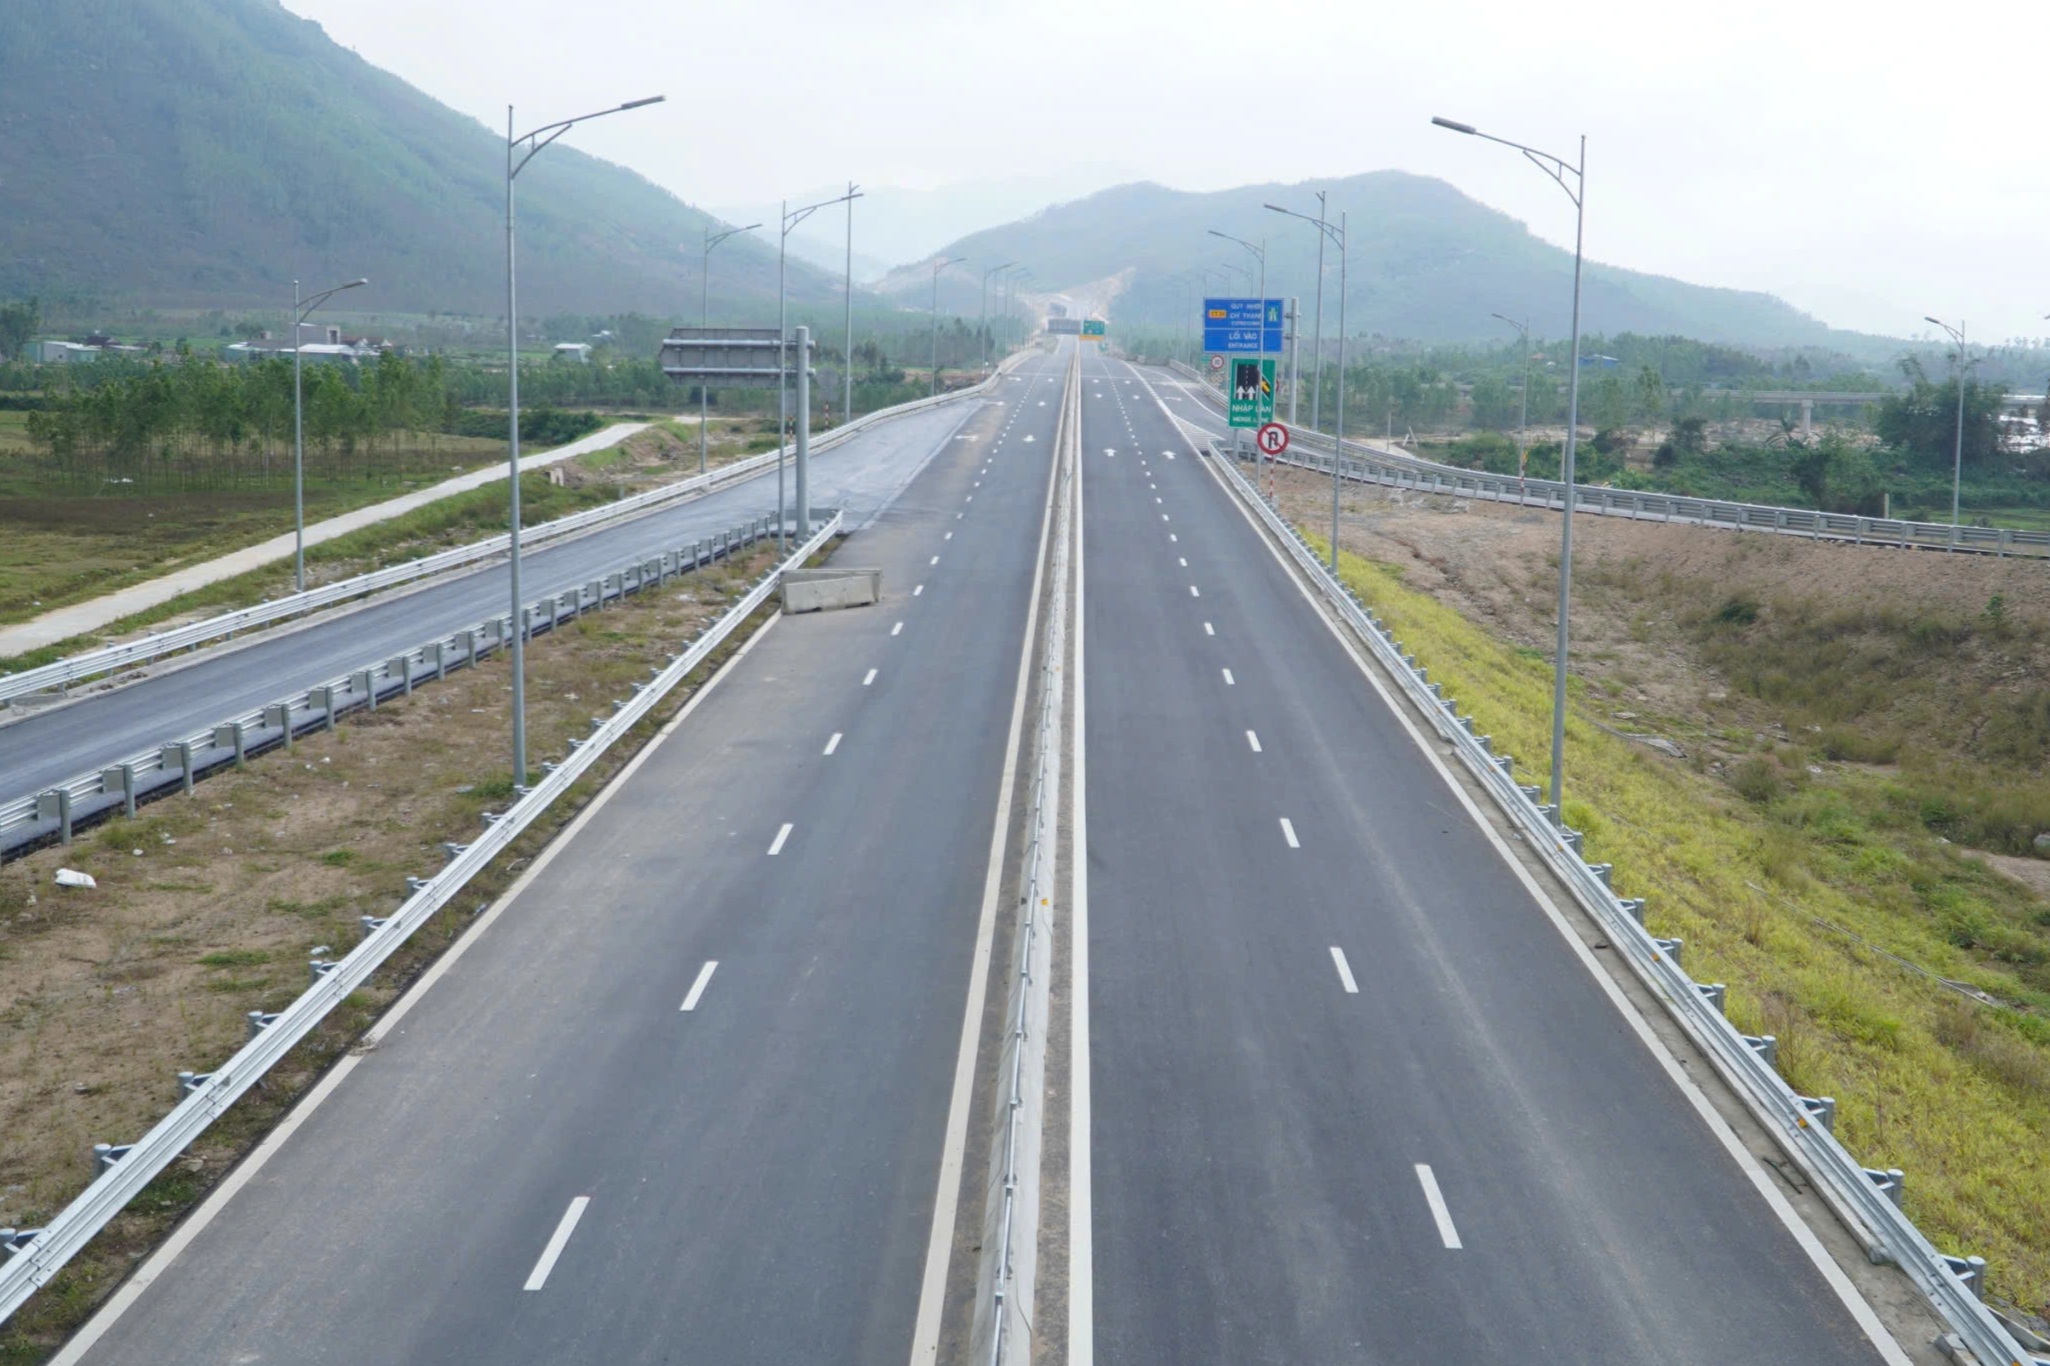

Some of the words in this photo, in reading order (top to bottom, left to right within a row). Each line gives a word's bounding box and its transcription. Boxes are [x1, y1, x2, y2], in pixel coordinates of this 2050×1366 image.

[1229, 330, 1241, 340] LỐI
[1243, 331, 1257, 340] VÀO
[1232, 403, 1253, 413] NHẬP
